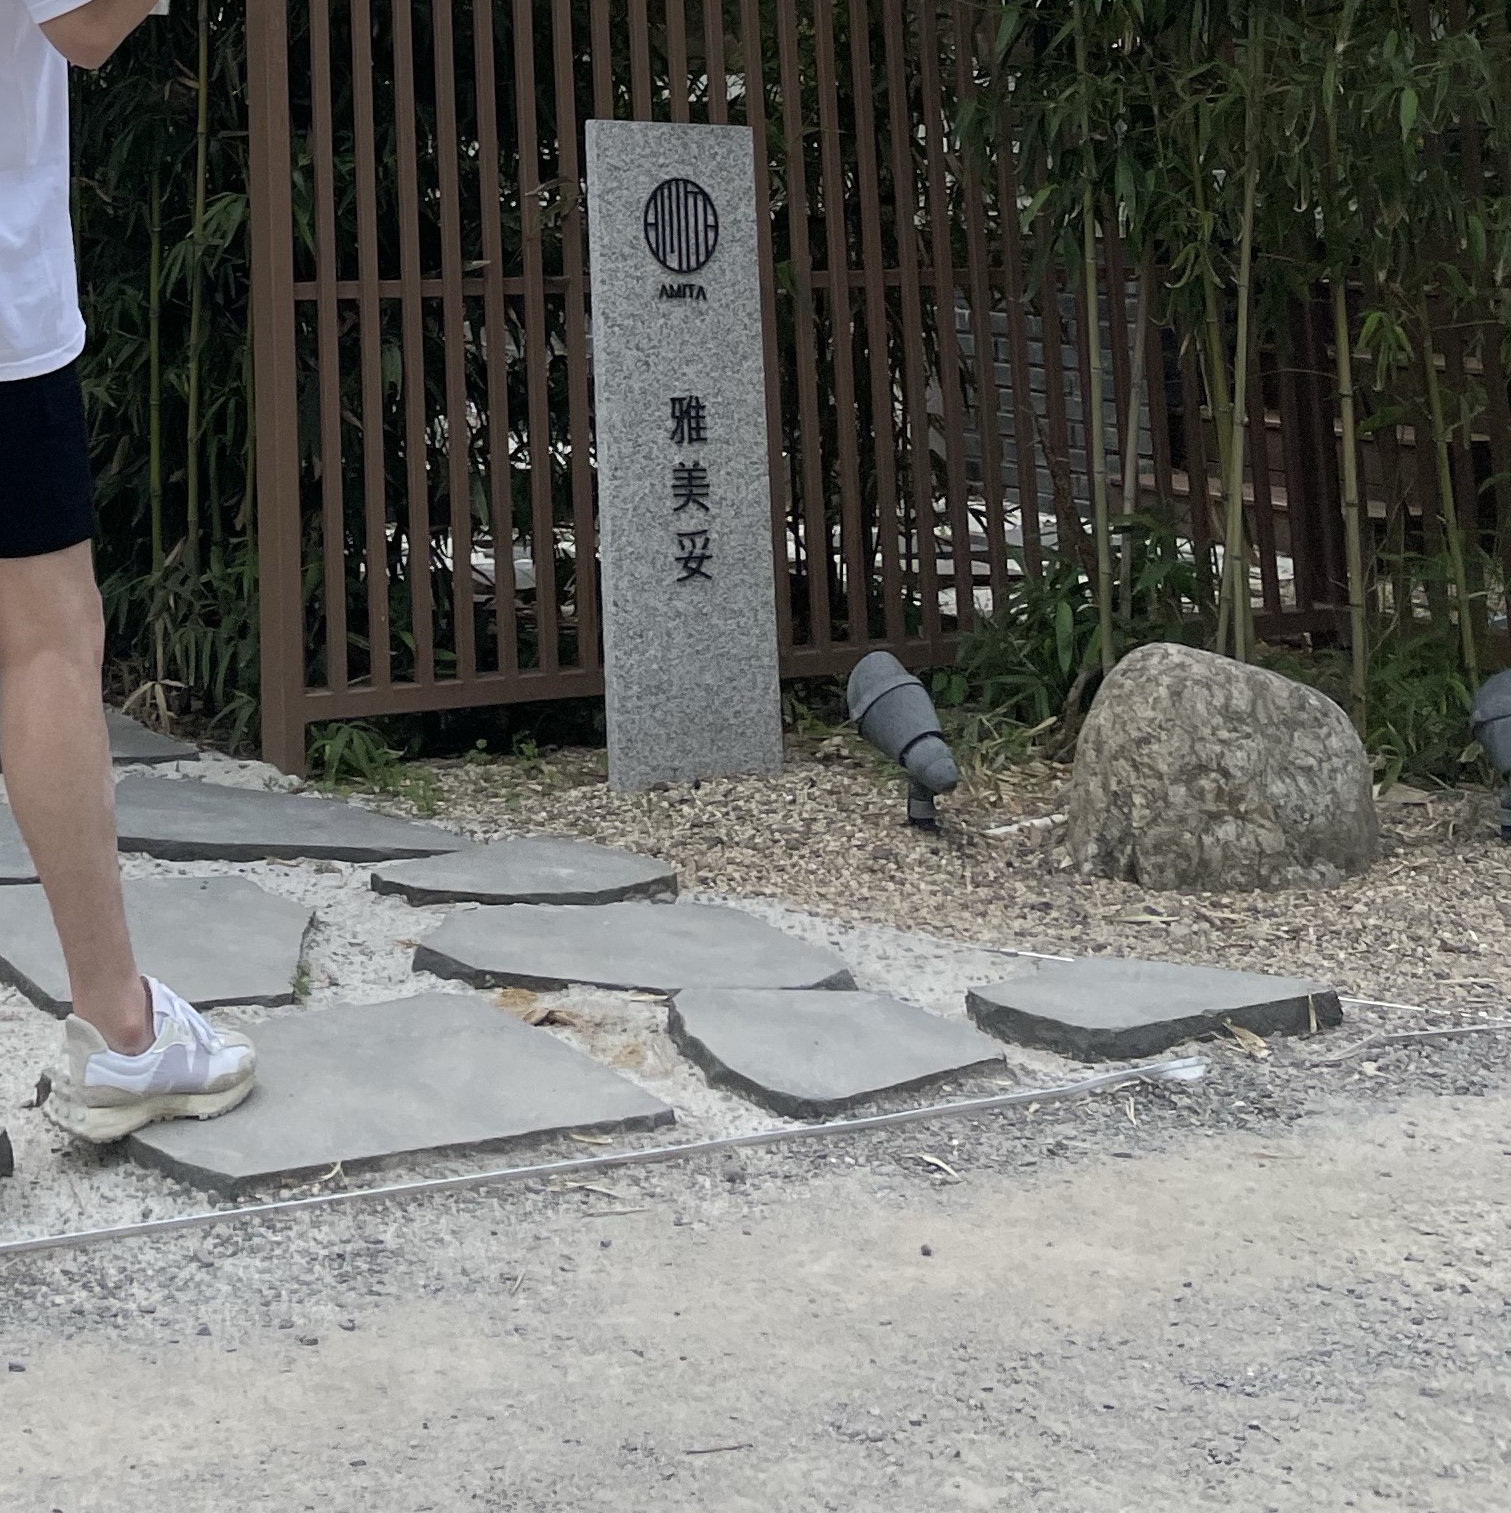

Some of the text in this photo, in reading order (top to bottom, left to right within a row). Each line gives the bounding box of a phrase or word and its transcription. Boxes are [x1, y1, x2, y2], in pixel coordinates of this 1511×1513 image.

[658, 283, 707, 301] AMITA
[670, 395, 713, 582] 雅美妥
